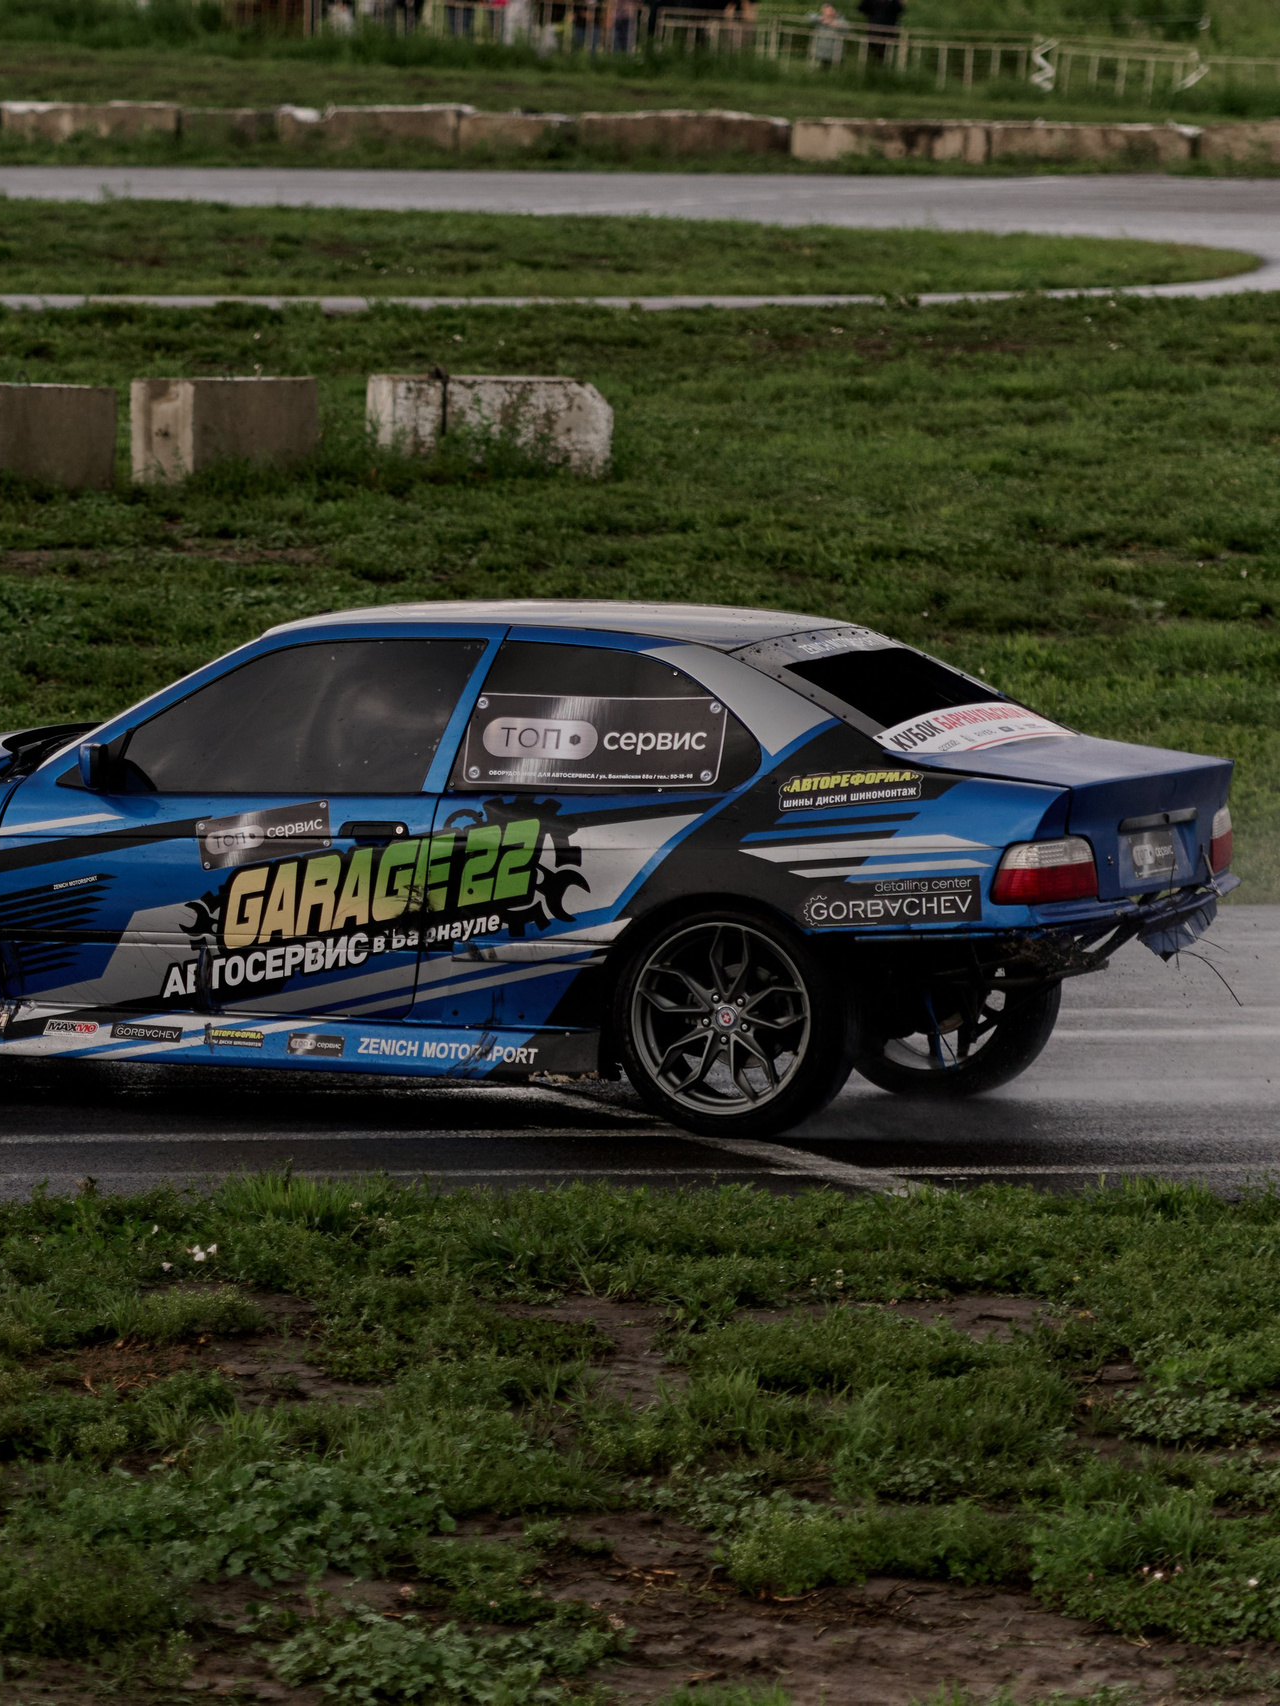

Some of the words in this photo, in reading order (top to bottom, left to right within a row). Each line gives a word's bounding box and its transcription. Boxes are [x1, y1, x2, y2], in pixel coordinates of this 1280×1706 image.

[501, 727, 562, 749] ТОП
[603, 731, 708, 755] сервис
[890, 720, 945, 751] КУБОК
[782, 771, 919, 793] «АВТОРЕФОРМА»
[783, 796, 814, 808] шины
[815, 794, 847, 807] диски
[850, 787, 917, 801] шиномонтаж
[213, 832, 246, 848] ТОП
[266, 818, 324, 838] сервис
[223, 832, 457, 950] GARAGE
[457, 818, 541, 908] 22
[874, 878, 929, 892] detailing
[931, 878, 972, 889] center
[373, 935, 386, 953] в
[316, 1042, 342, 1050] сервис
[357, 1037, 419, 1057] ZENICH
